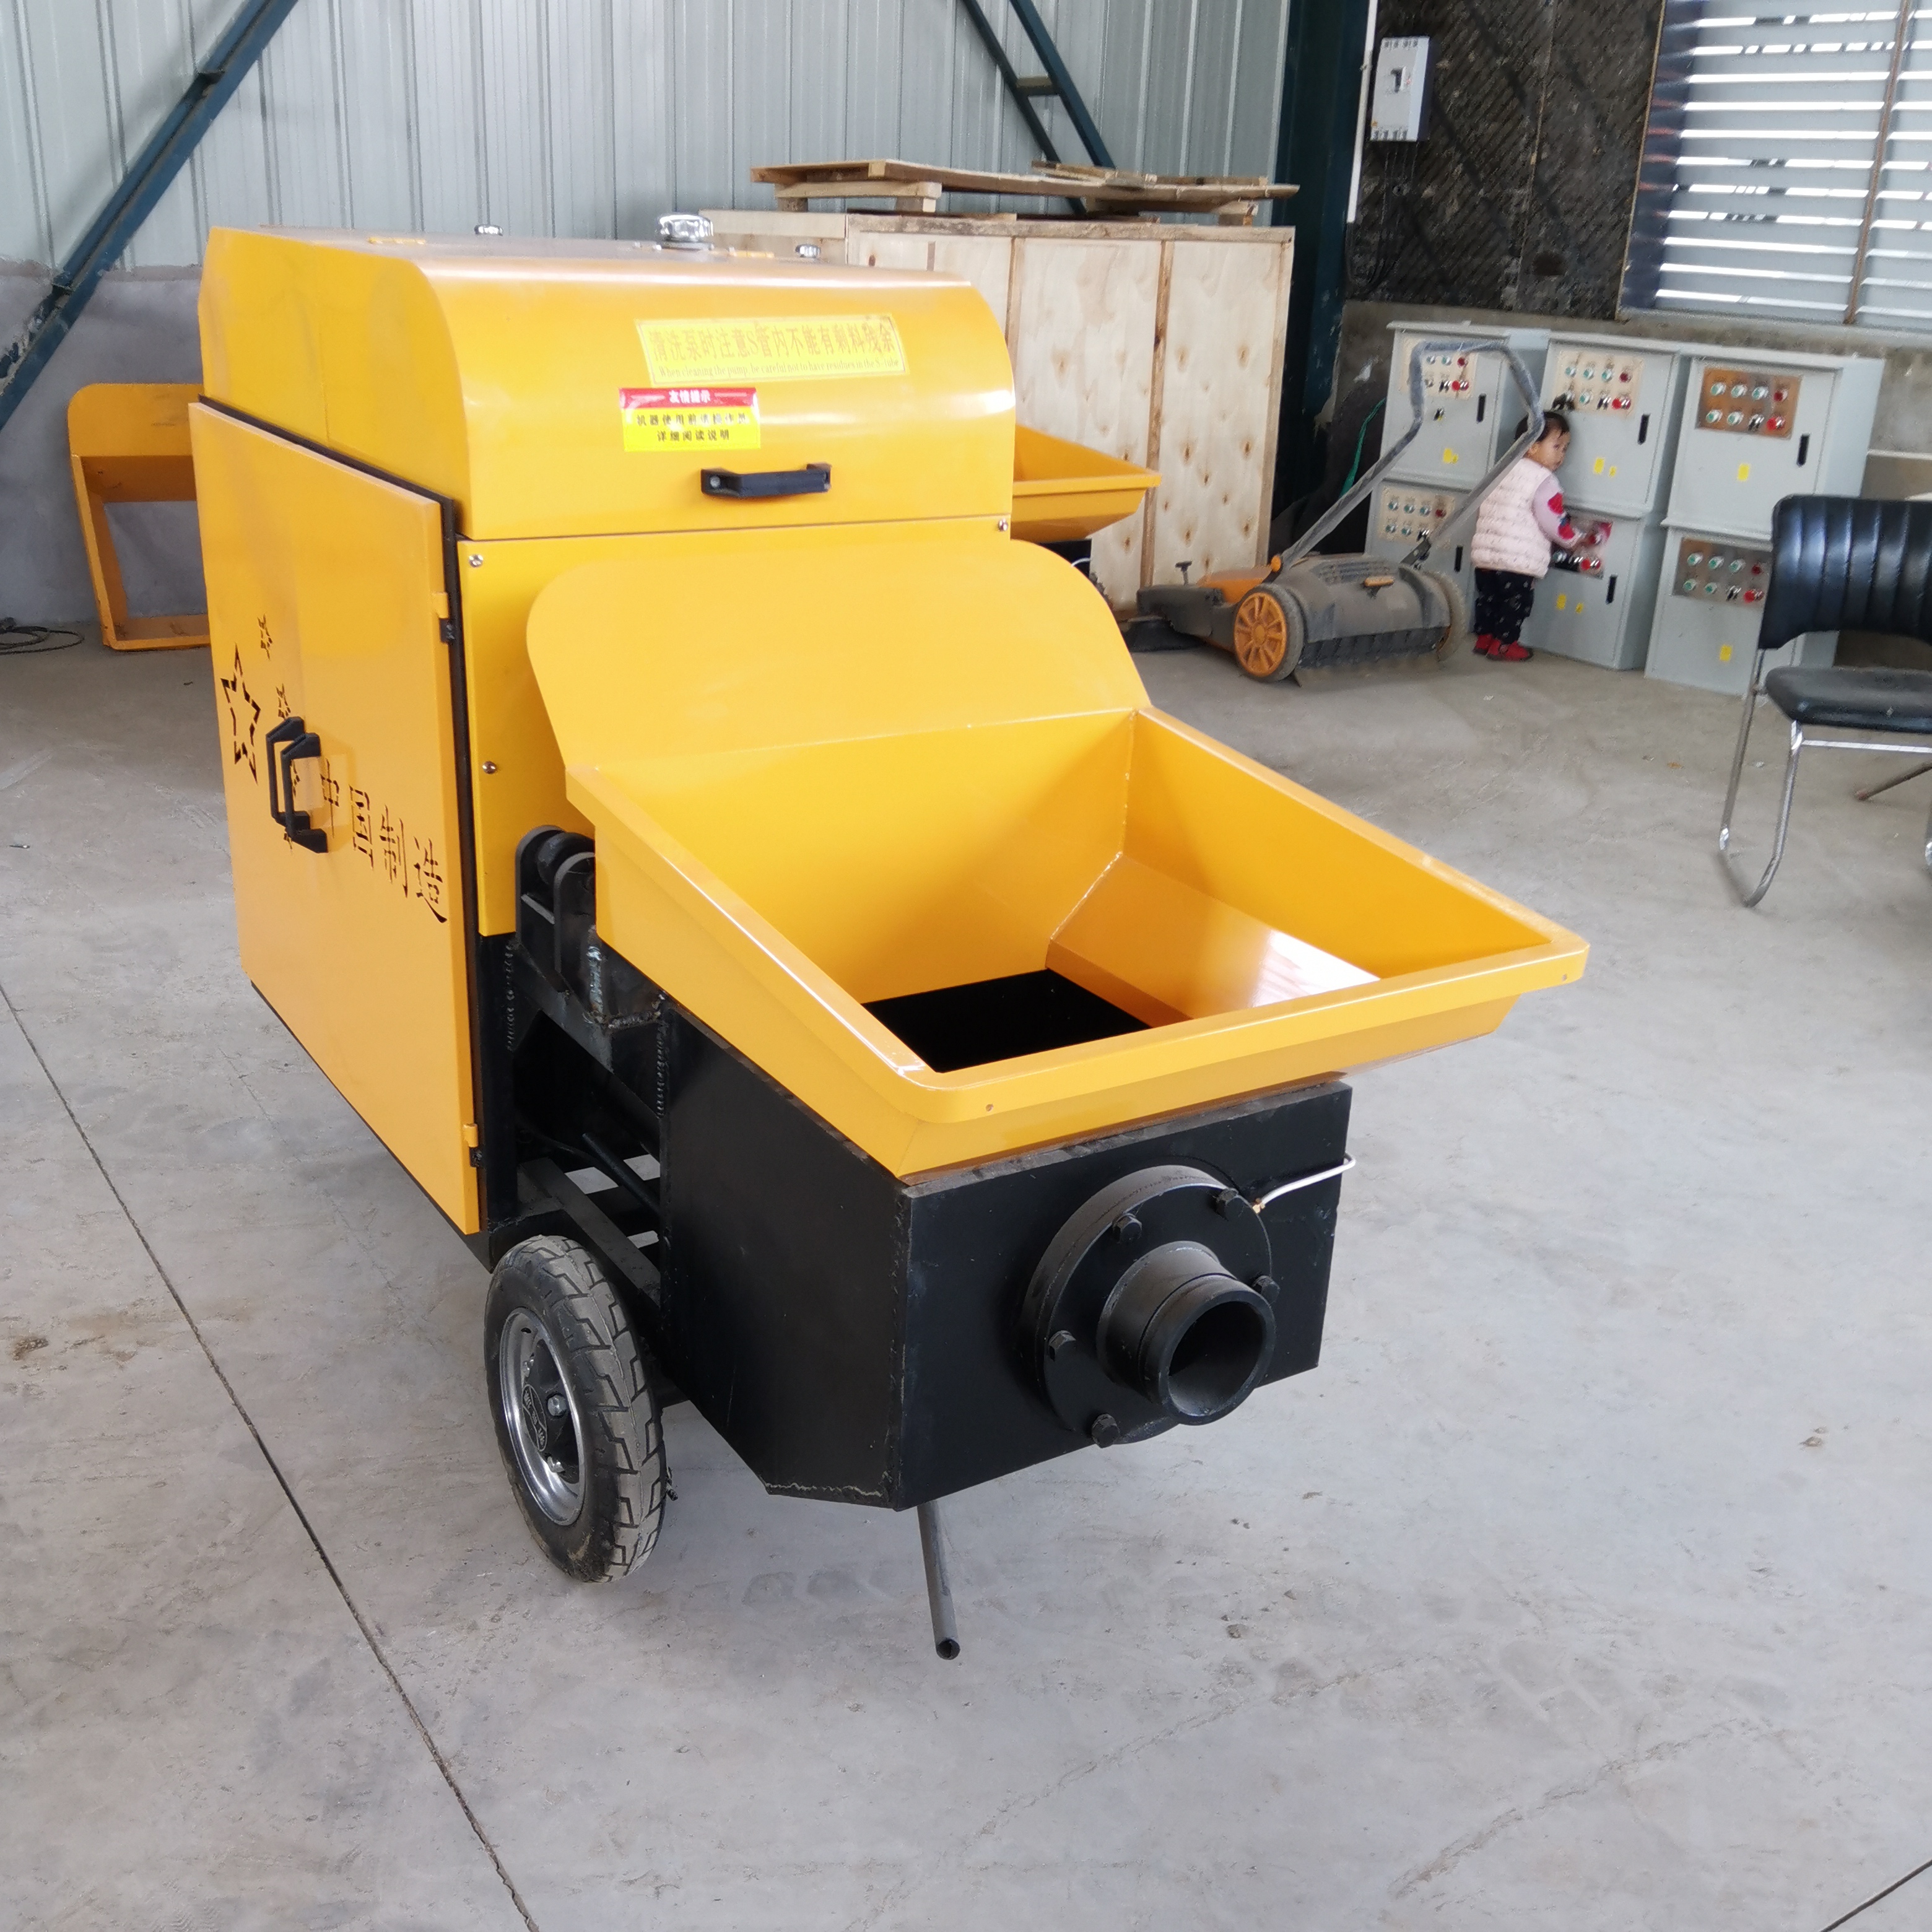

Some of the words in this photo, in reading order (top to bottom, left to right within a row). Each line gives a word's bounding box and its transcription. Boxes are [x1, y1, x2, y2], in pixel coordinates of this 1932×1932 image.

[658, 365, 681, 378] When
[682, 365, 714, 378] cleaning
[714, 363, 726, 376] the
[750, 362, 759, 373] be
[761, 362, 786, 373] careful
[787, 362, 799, 372] not
[799, 361, 807, 371] to
[807, 360, 825, 371] have
[826, 359, 855, 371] residues
[856, 359, 863, 369] in
[863, 358, 874, 368] the
[668, 389, 711, 404] 友情提示
[320, 758, 448, 924] 中国制造
